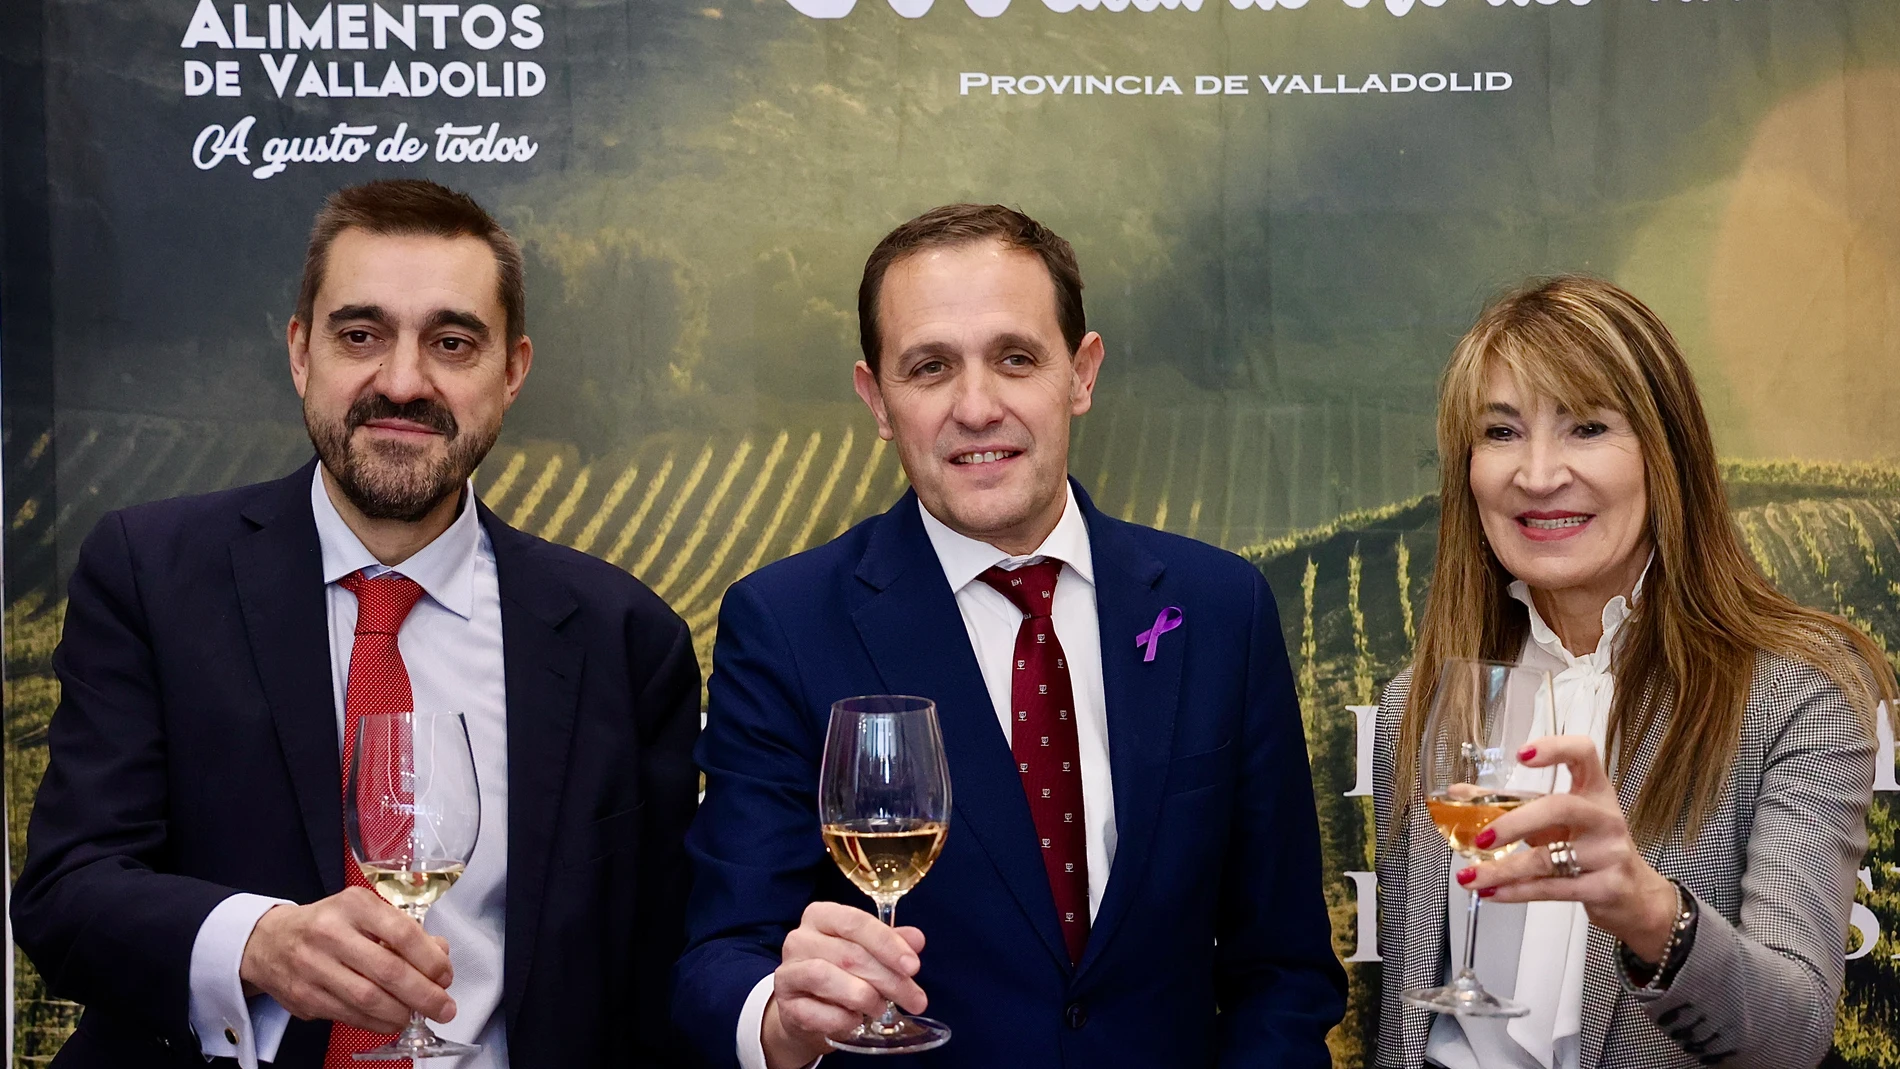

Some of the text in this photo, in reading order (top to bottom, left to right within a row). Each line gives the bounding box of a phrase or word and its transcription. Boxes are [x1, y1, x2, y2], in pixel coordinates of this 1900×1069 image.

[180, 0, 545, 51] ALIMENTOS
[184, 53, 547, 99] DE VALLADOLID
[959, 71, 1513, 96] PROVINCIA DE VALLADOLID
[192, 115, 539, 180] A gusto de todos
